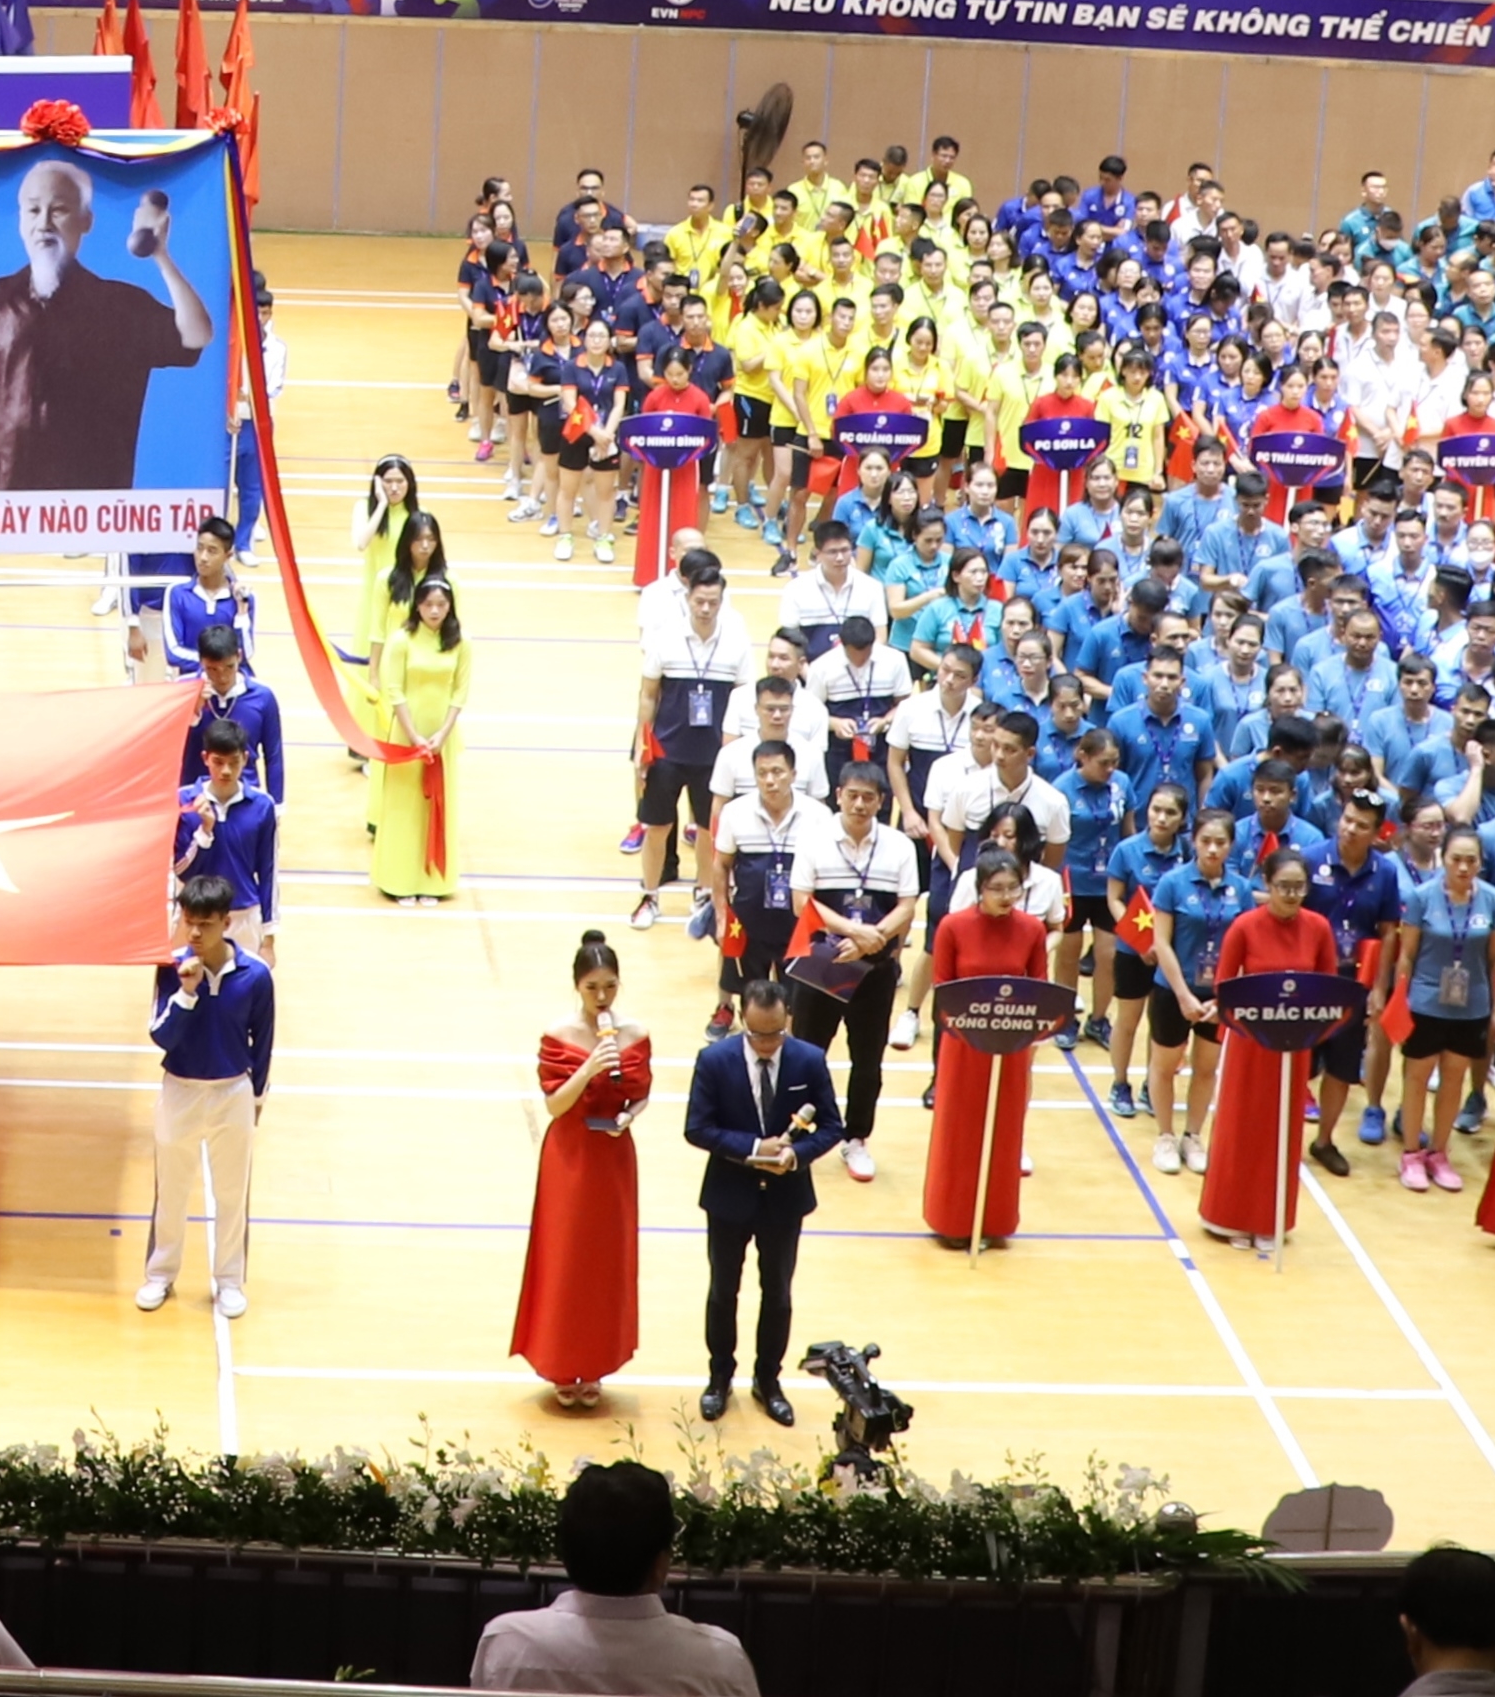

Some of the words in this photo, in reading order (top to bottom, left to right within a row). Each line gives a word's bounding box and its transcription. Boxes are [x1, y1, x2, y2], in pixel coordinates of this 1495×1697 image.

[651, 6, 707, 20] EVNNPC
[1073, 3, 1137, 37] BẠN
[1146, 1, 1187, 33] SẼ
[1192, 3, 1310, 39] KHÔNG
[1319, 9, 1389, 43] THỂ
[1389, 11, 1490, 50] CHIẾN
[630, 436, 645, 446] PC
[1035, 440, 1051, 450] PC
[1080, 438, 1095, 449] LA
[38, 499, 88, 534] NÀO
[96, 498, 161, 534] CŨNG
[969, 1001, 991, 1016] CƠ
[994, 1002, 1038, 1018] QUAN
[1233, 1007, 1258, 1021] PC
[1262, 1004, 1299, 1021] BẮC
[1303, 1006, 1343, 1023] KẠN
[946, 1014, 989, 1030] TỔNG
[991, 1016, 1033, 1031] CÔNG
[1036, 1018, 1057, 1032] TY
